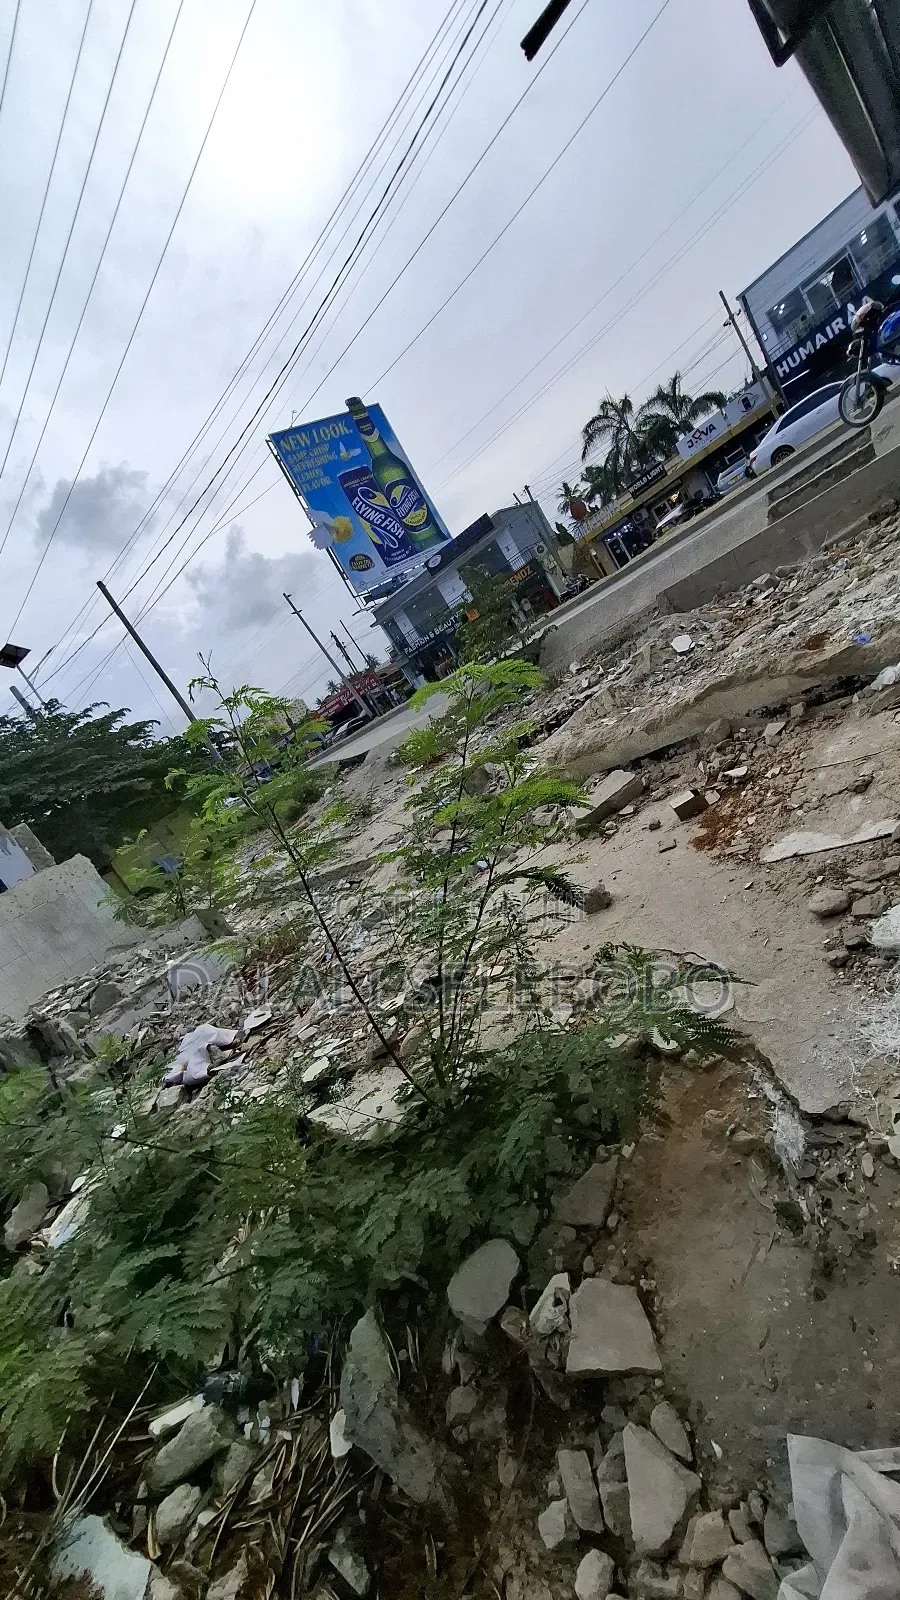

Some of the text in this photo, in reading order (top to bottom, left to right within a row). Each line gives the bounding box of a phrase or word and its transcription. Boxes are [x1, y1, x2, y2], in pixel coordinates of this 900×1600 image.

[280, 431, 311, 454] NEW
[628, 475, 648, 495] WORLD
[648, 464, 664, 484] LIGHT
[351, 496, 386, 525] FLYING
[381, 516, 406, 539] FISH
[404, 634, 430, 655] FASHION
[435, 613, 460, 637] BEAUTY
